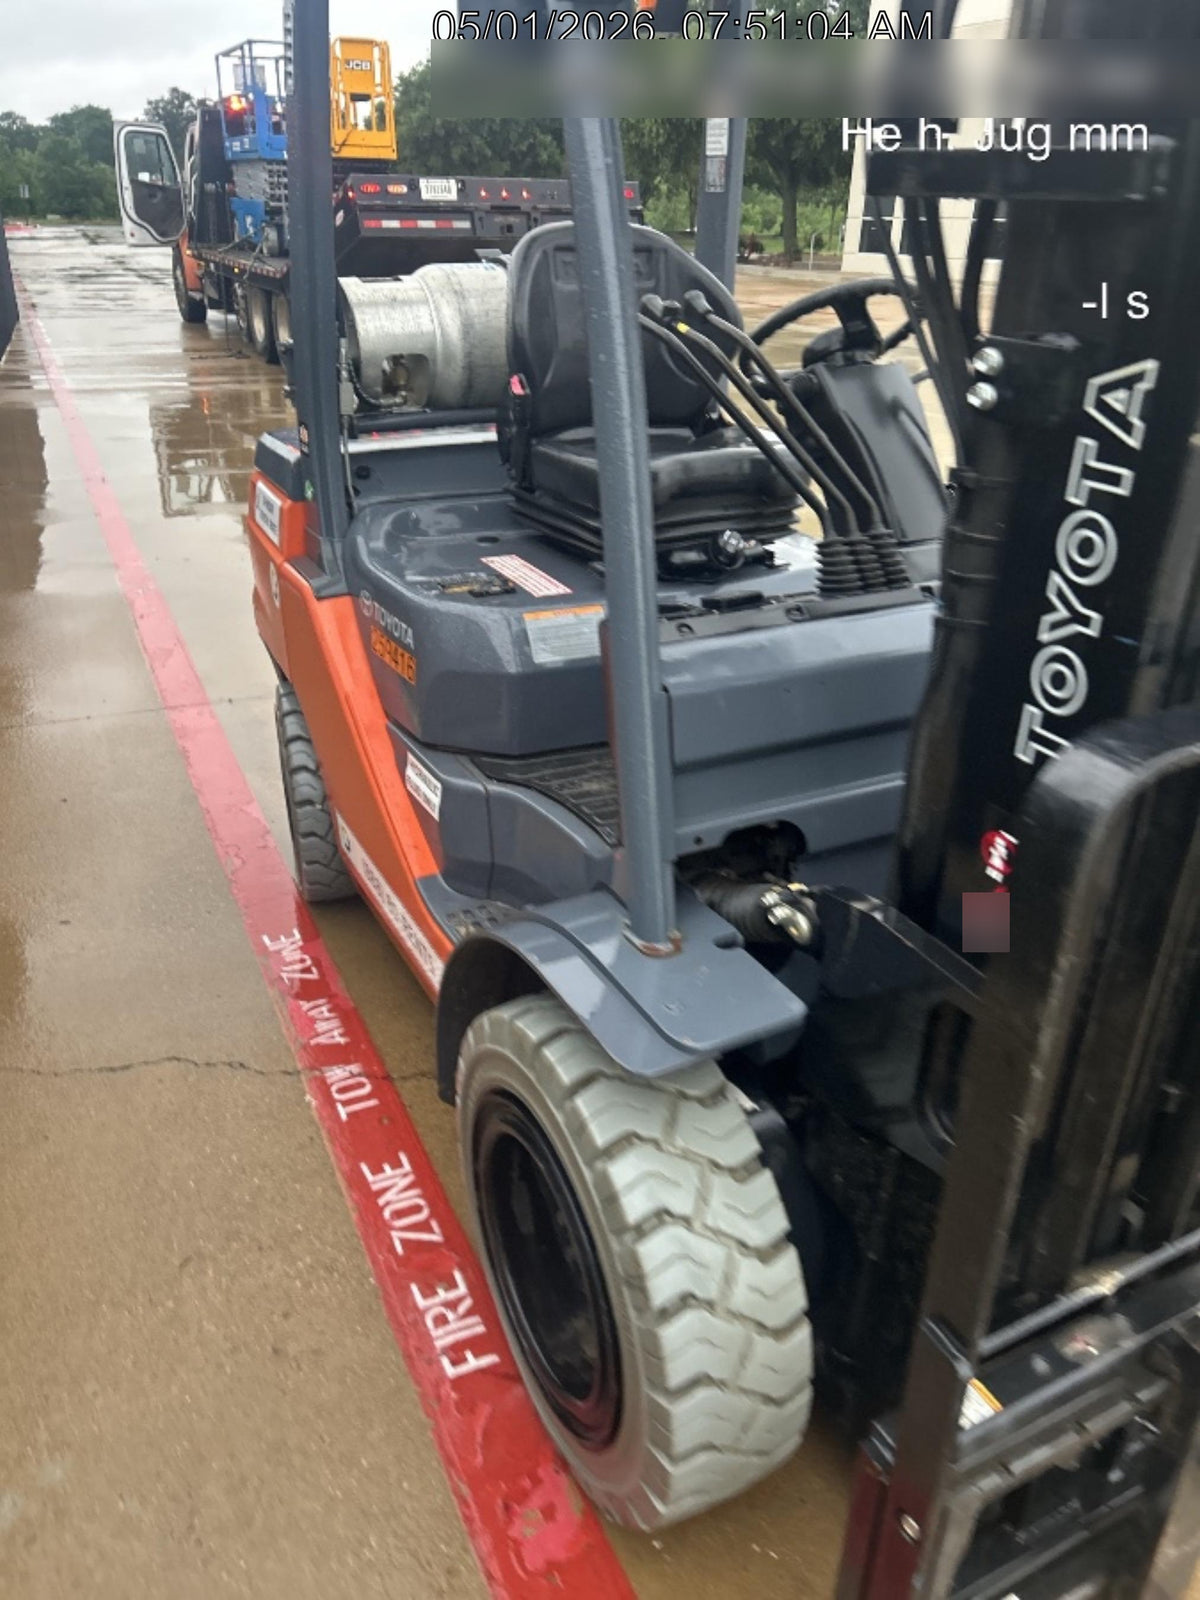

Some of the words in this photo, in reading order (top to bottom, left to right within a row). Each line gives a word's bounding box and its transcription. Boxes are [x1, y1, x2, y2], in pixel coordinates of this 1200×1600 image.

[345, 59, 371, 70] JCB
[1014, 358, 1160, 765] TOYOTA
[374, 600, 415, 650] TOYOTA
[262, 927, 320, 985] ZONE
[299, 998, 350, 1046] AWAY
[321, 1062, 380, 1122] TOW
[360, 1151, 445, 1256] ZONE
[410, 1269, 500, 1380] FIRE
